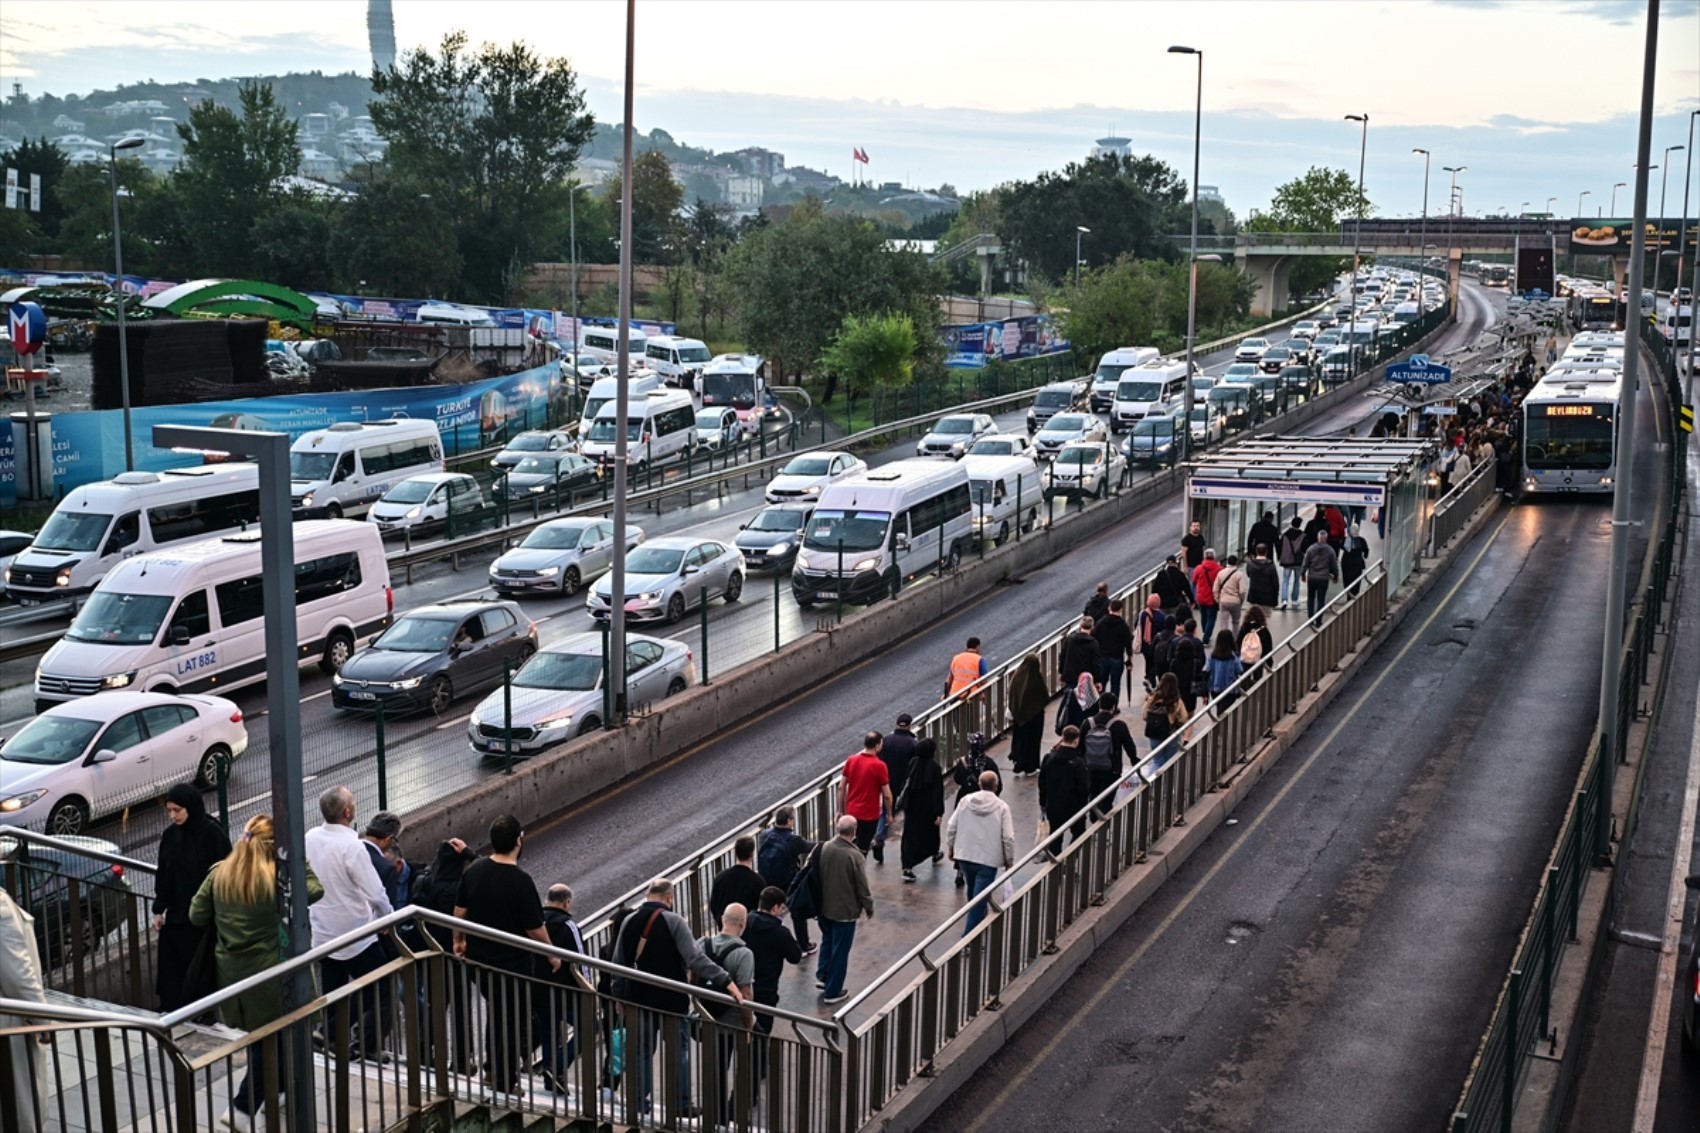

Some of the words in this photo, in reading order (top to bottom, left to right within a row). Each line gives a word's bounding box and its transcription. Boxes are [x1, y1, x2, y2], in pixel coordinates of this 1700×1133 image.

[10, 308, 30, 343] M
[1390, 370, 1446, 381] ALTUNİZADE
[177, 657, 197, 675] LAT
[199, 651, 216, 668] 882
